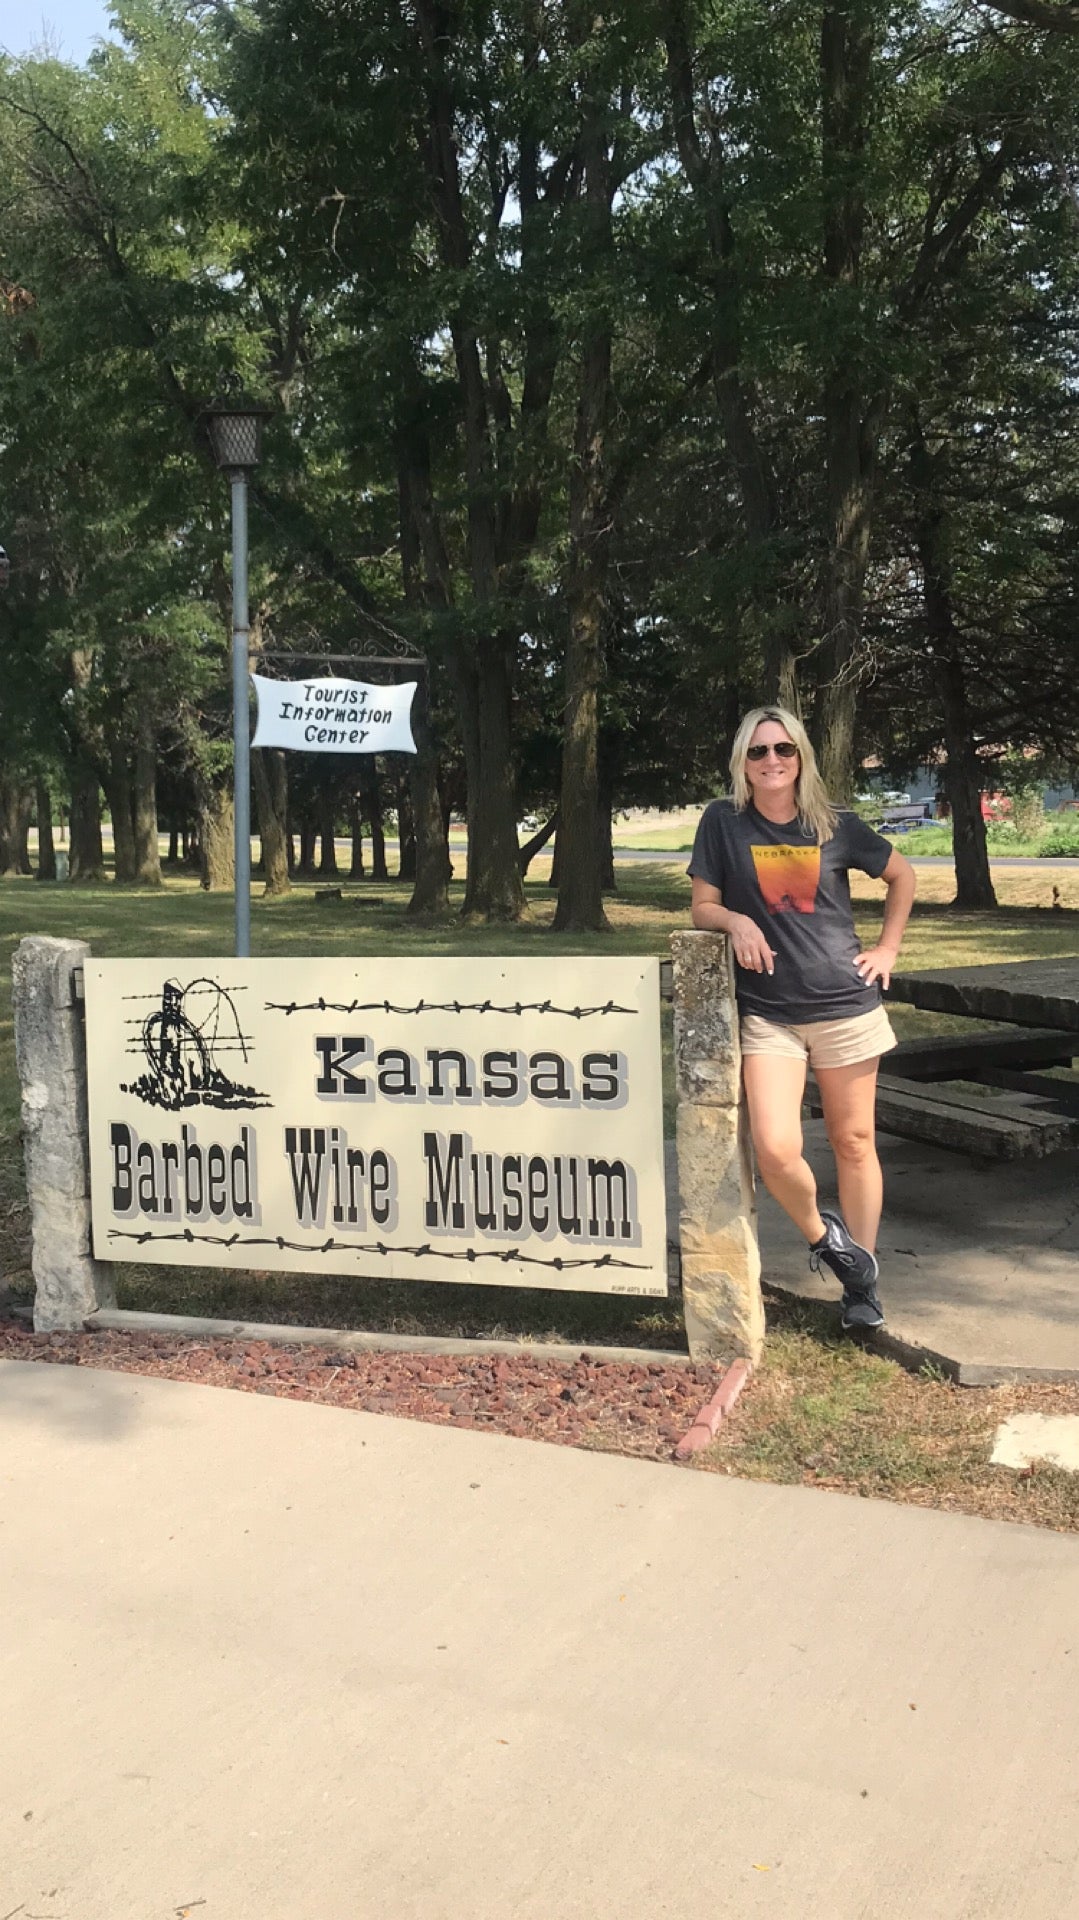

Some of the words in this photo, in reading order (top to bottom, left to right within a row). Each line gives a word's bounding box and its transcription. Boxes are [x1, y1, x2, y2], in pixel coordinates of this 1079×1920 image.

[304, 684, 369, 705] Tourist
[279, 702, 392, 724] Information
[304, 725, 370, 744] Center
[755, 849, 818, 858] NEBRASKA
[314, 1035, 624, 1104] Kansas
[109, 1122, 256, 1220] Barbed
[284, 1126, 393, 1226] Wire
[423, 1131, 636, 1242] Museum
